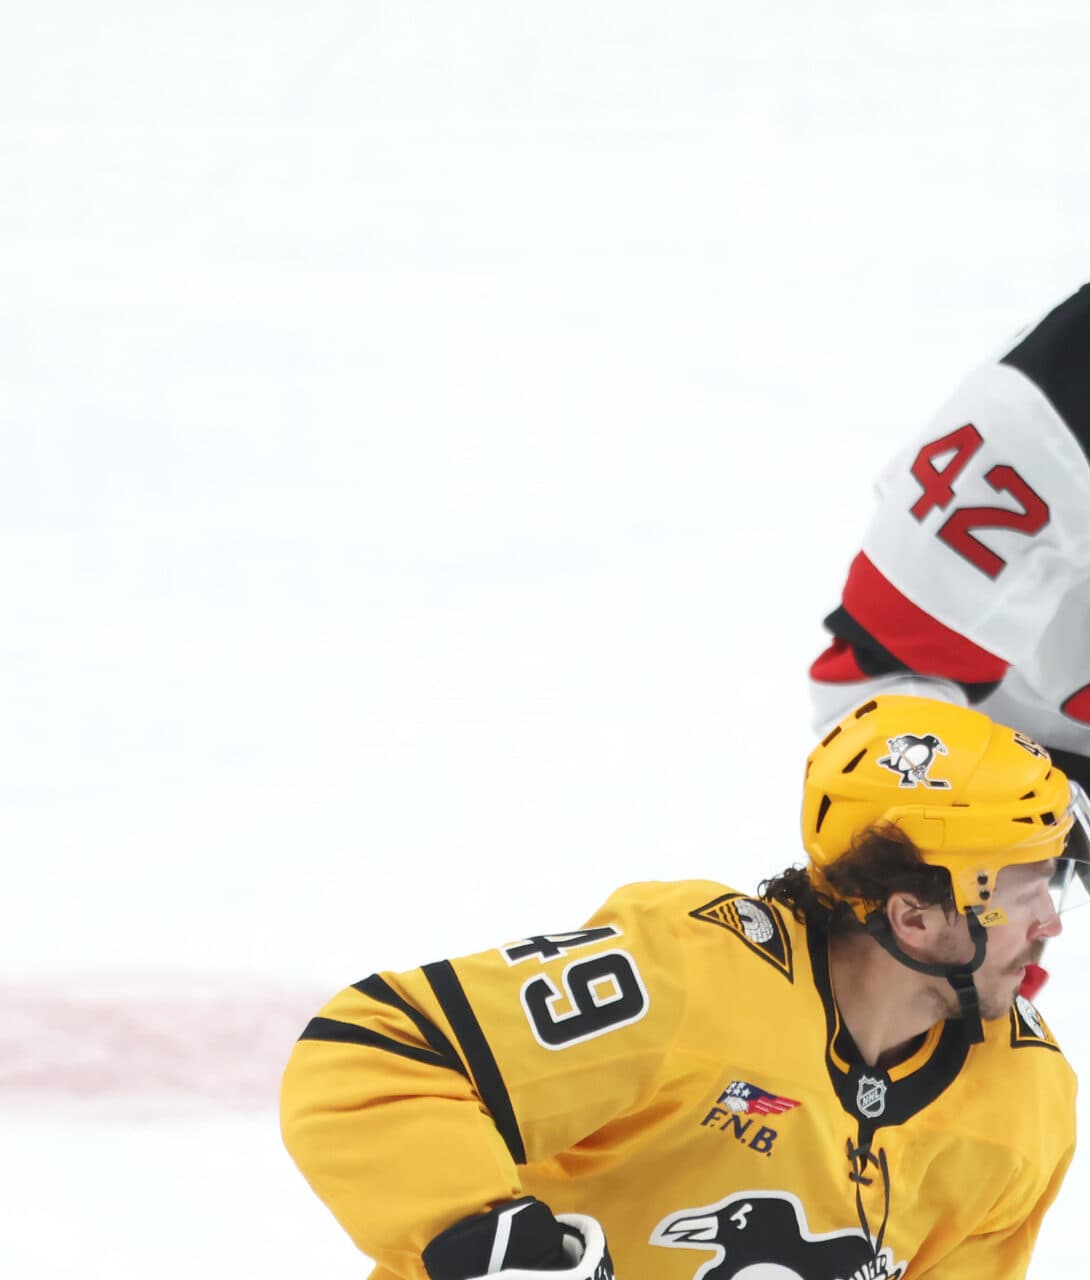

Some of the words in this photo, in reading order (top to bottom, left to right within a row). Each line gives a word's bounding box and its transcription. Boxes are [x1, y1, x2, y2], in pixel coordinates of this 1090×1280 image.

[908, 422, 1051, 583] 42
[500, 922, 650, 1051] 49
[700, 1107, 778, 1157] F.N.B.
